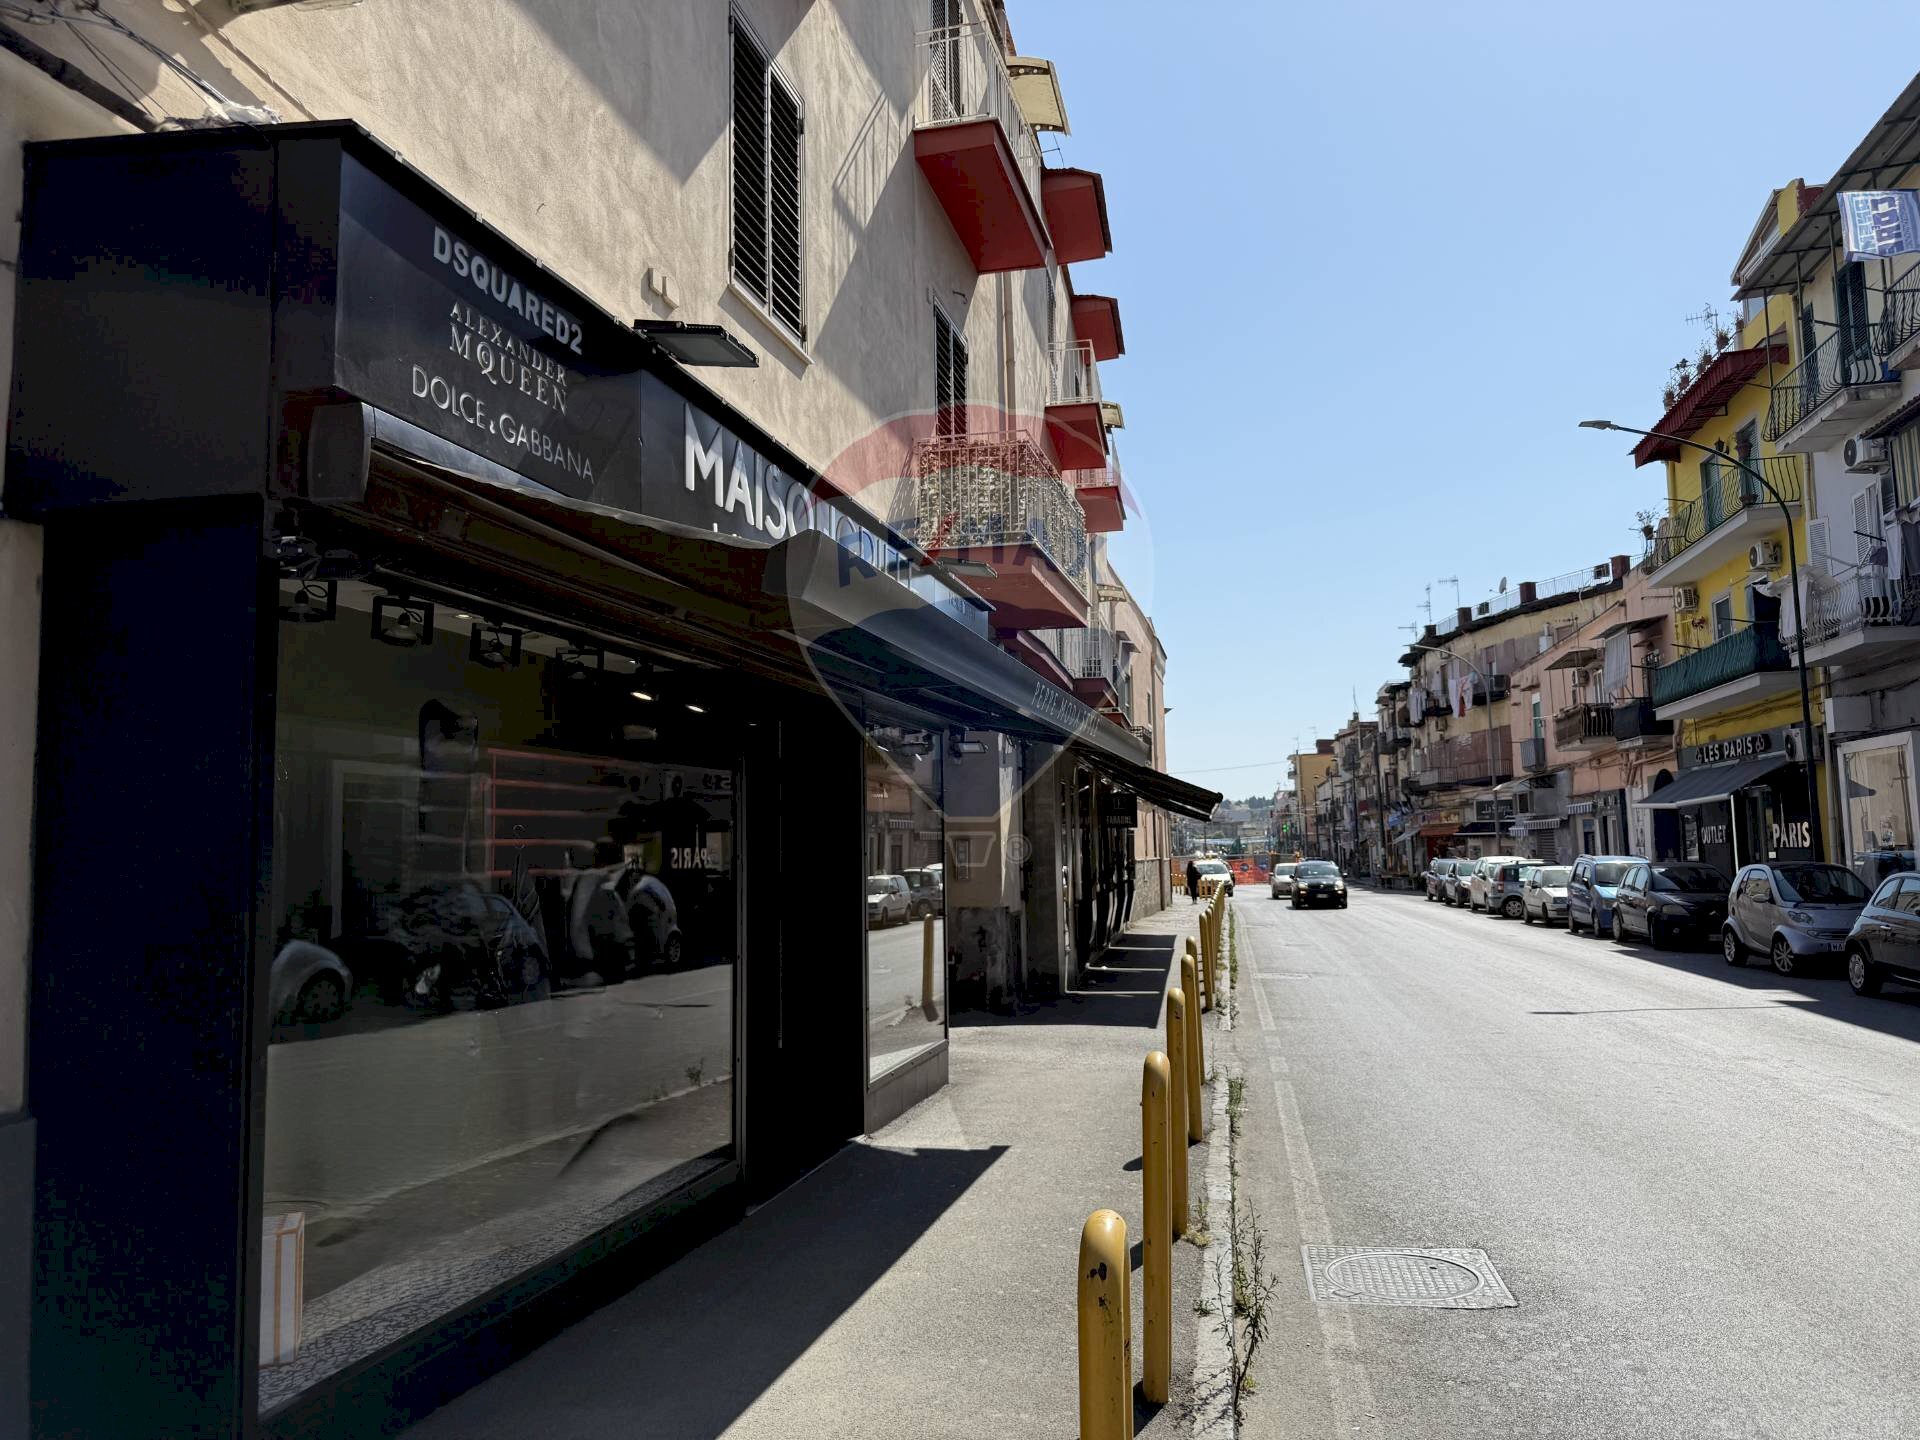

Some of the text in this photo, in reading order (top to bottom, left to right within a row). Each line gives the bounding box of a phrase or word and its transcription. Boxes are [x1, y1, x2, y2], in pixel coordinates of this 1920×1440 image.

[433, 226, 583, 355] DSQUARED2
[450, 301, 568, 388] ALEXANDER
[412, 363, 486, 430] DOLCE
[498, 413, 595, 485] GABBANA
[1703, 735, 1754, 763] LES PARIS
[1701, 824, 1728, 844] OUTLET
[1772, 821, 1811, 849] PARIS
